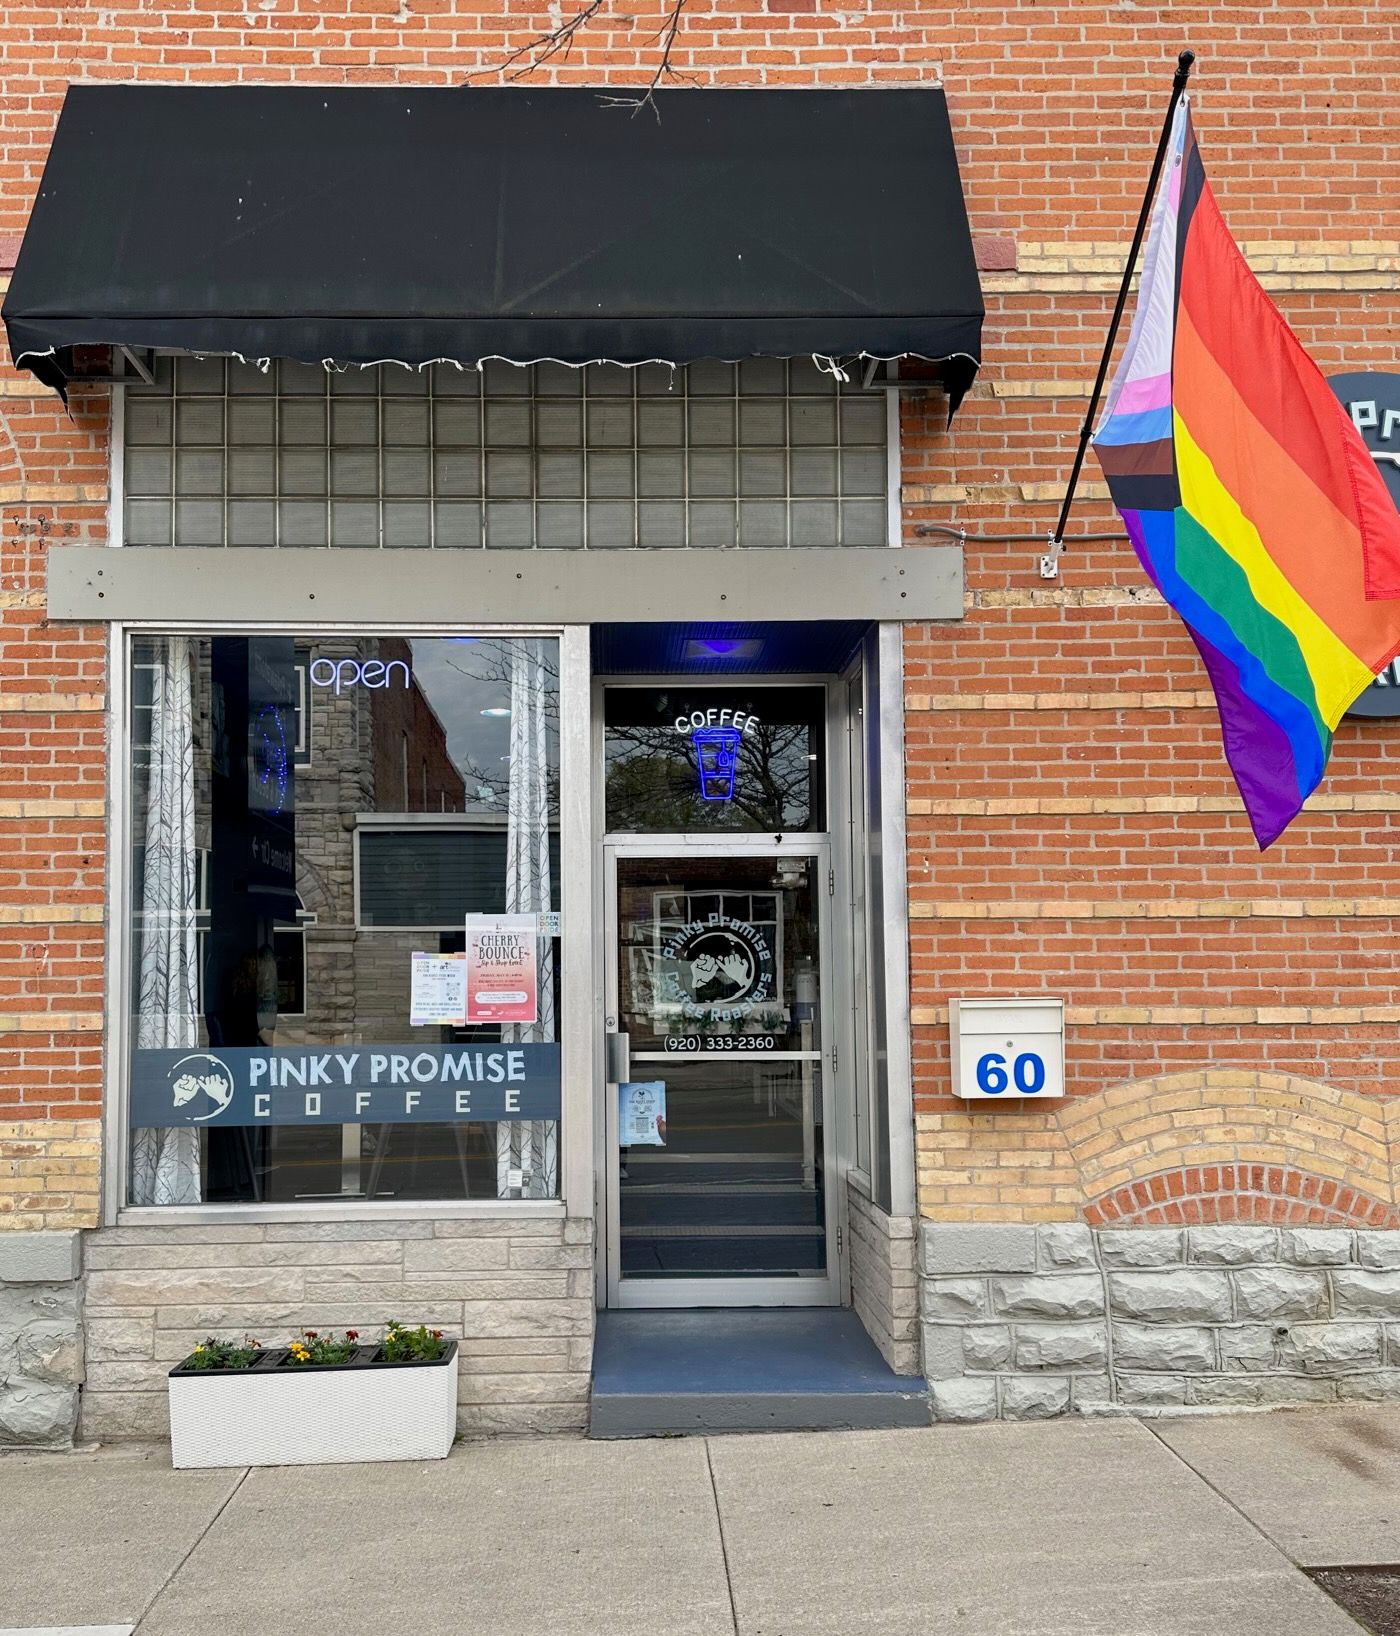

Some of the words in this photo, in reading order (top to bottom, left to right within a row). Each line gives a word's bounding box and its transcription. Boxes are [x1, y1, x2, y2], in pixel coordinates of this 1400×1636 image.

[309, 658, 410, 695] open
[675, 708, 760, 734] COFFEE
[479, 946, 524, 960] BOUNCE
[481, 935, 520, 947] CHERRY
[663, 919, 705, 960] Pinky
[710, 972, 773, 1022] Roasters
[664, 1034, 702, 1053] (920)
[706, 1036, 775, 1050] 333-2360
[250, 1053, 360, 1088] PINKY
[370, 1050, 526, 1084] PROMISE
[976, 1052, 1046, 1095] 60
[254, 1089, 521, 1117] COFFEE
